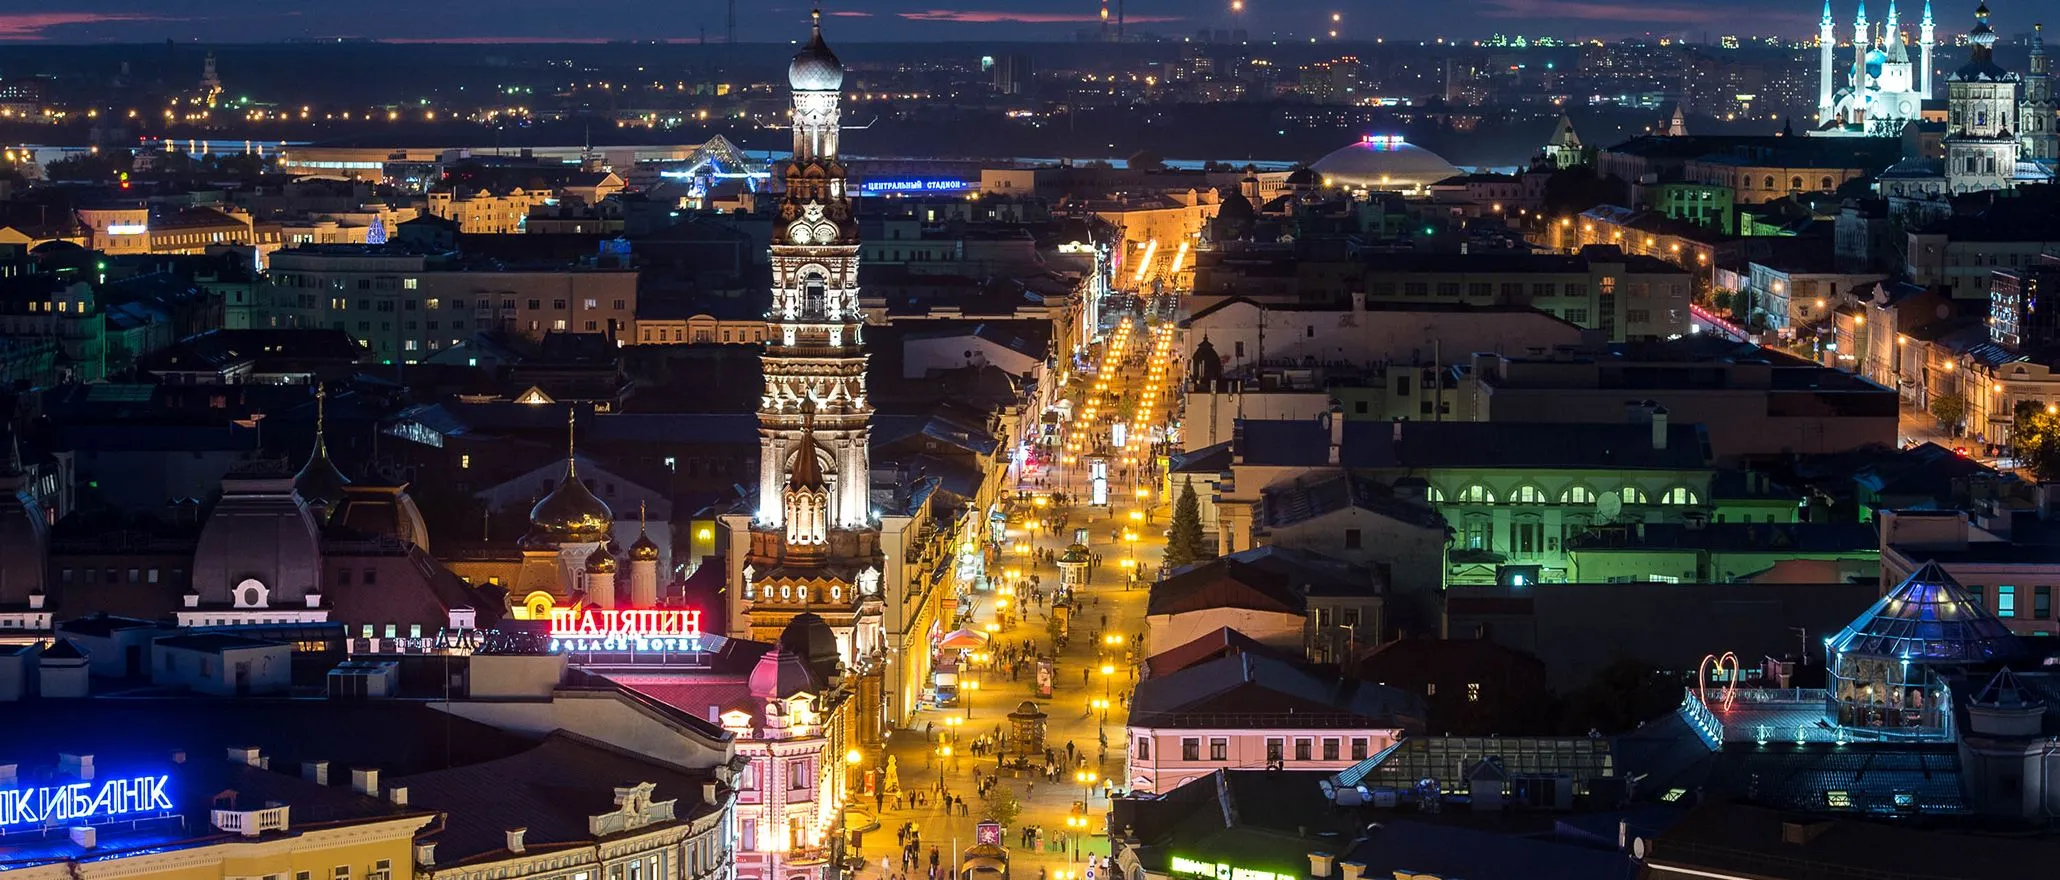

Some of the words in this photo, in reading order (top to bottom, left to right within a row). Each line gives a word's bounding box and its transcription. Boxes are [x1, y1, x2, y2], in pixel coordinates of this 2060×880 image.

[868, 181, 922, 191] ЦЕНТРАЛЬНЫЙ
[927, 181, 960, 190] СТАДИОН
[550, 609, 702, 635] ШАЛЯПИН
[550, 638, 628, 651] PALACE
[636, 638, 702, 651] HOTEL
